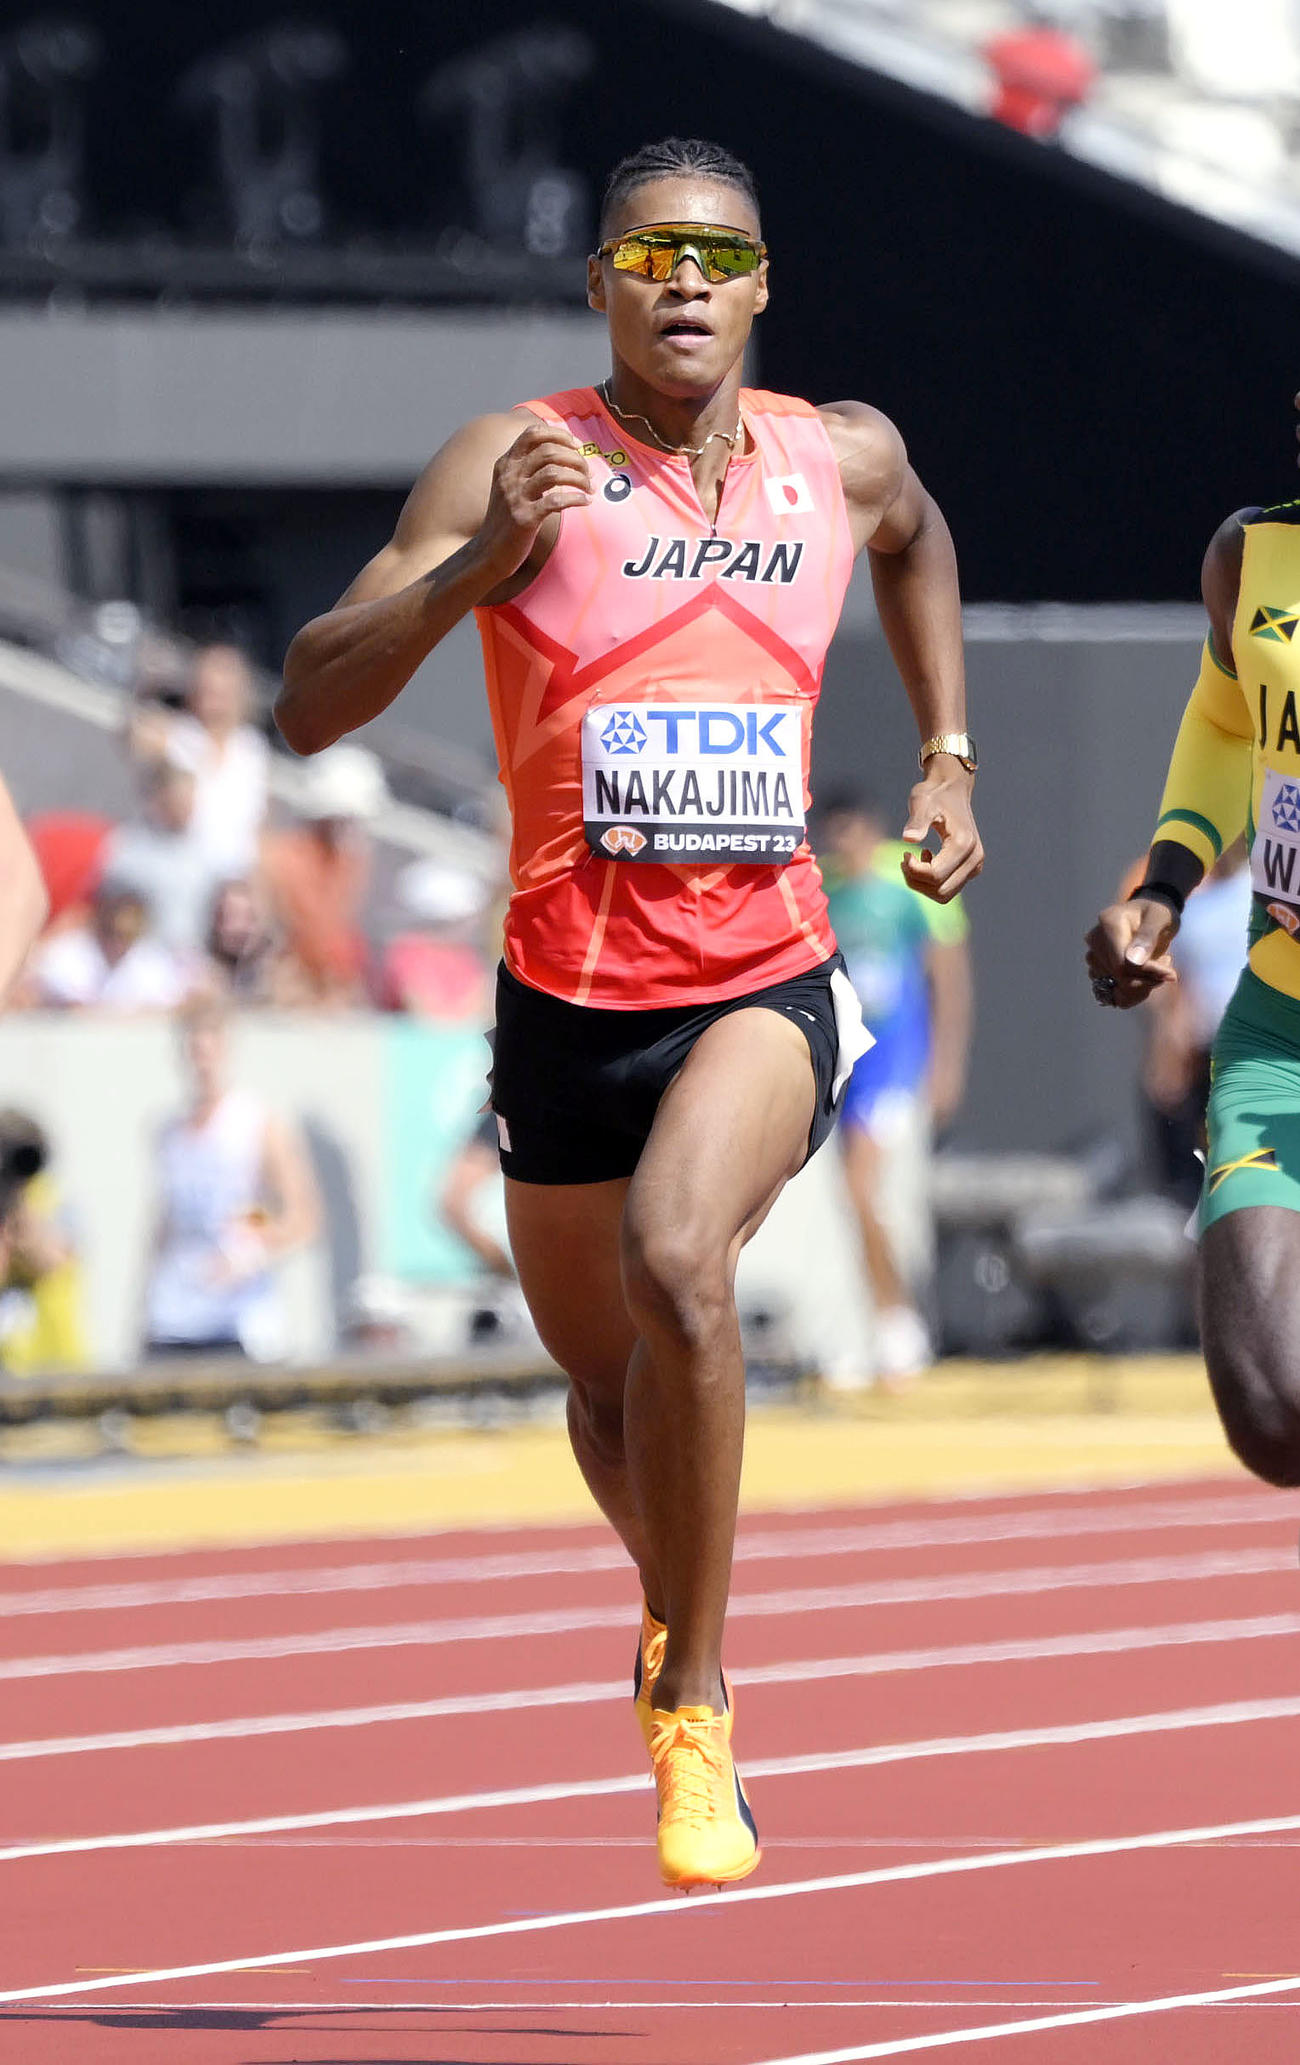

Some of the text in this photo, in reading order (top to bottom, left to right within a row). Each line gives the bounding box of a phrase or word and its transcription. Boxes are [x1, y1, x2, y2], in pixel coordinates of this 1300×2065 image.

[622, 536, 804, 584] JAPAN
[647, 710, 787, 756] TDK
[594, 769, 794, 818] NAKAJIMA
[653, 833, 796, 853] BUDAPEST 23
